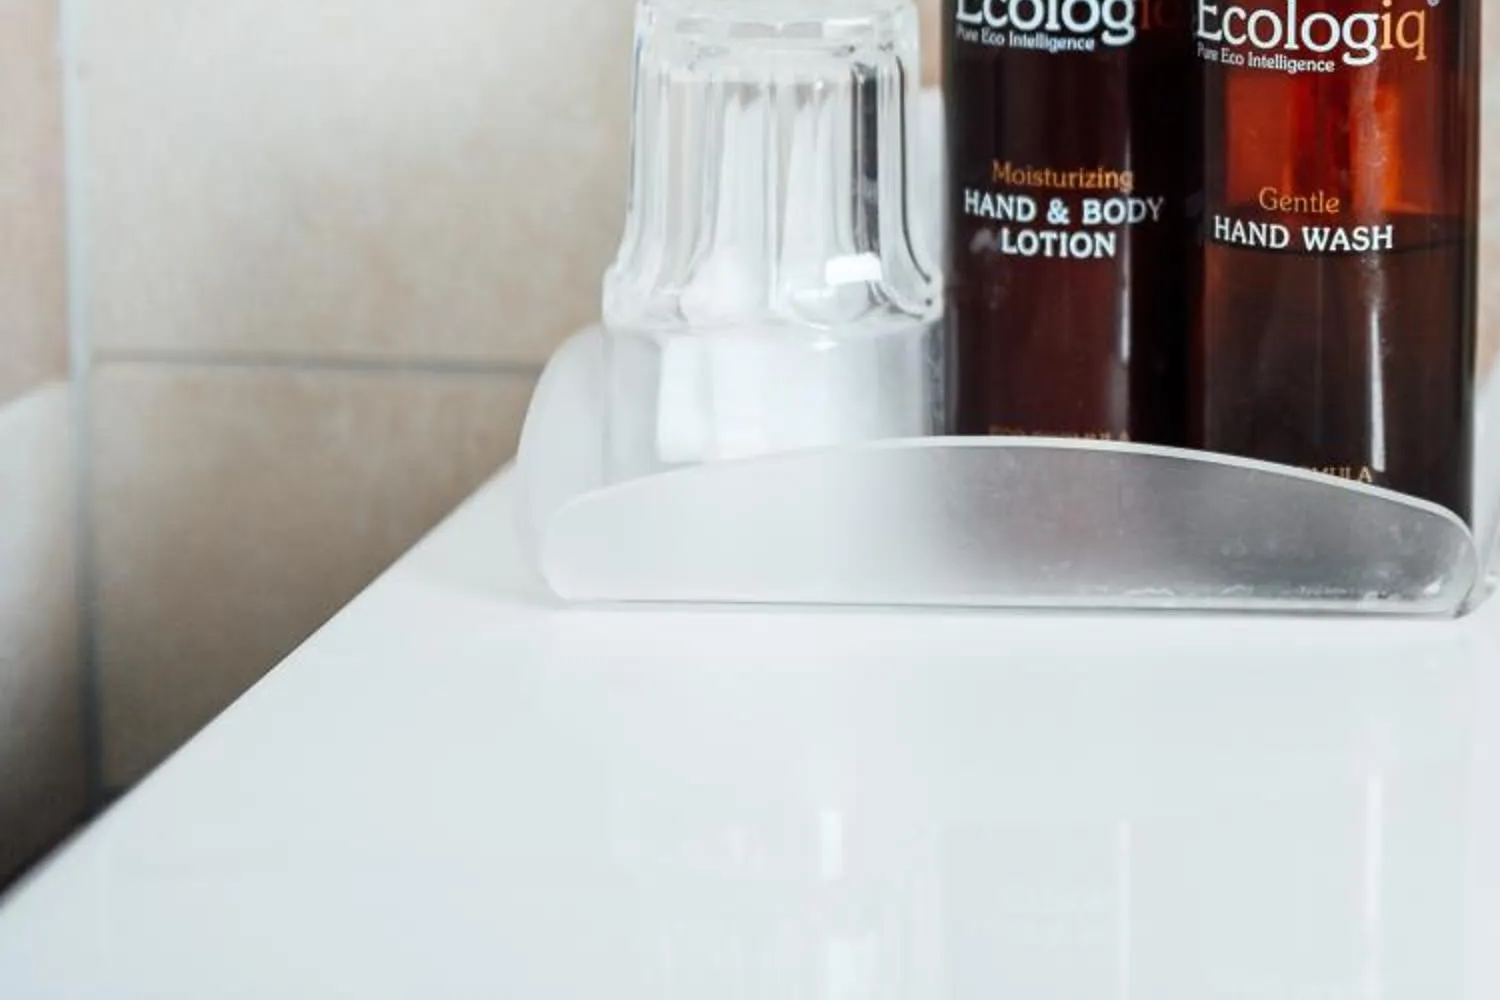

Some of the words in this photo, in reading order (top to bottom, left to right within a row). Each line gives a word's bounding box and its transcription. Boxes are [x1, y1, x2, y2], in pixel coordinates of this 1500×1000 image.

[981, 29, 1005, 46] Eco
[1009, 30, 1095, 52] Intelligence
[1220, 47, 1244, 66] Eco
[1248, 51, 1335, 74] Intelligence
[992, 160, 1133, 192] Moisturizing
[964, 188, 1037, 222] HAND
[1046, 198, 1071, 225] &
[1082, 197, 1164, 225] BODY
[1258, 187, 1340, 214] Gentle
[1001, 227, 1117, 258] LOTION
[1213, 215, 1290, 249] HAND
[1302, 224, 1393, 252] WASH
